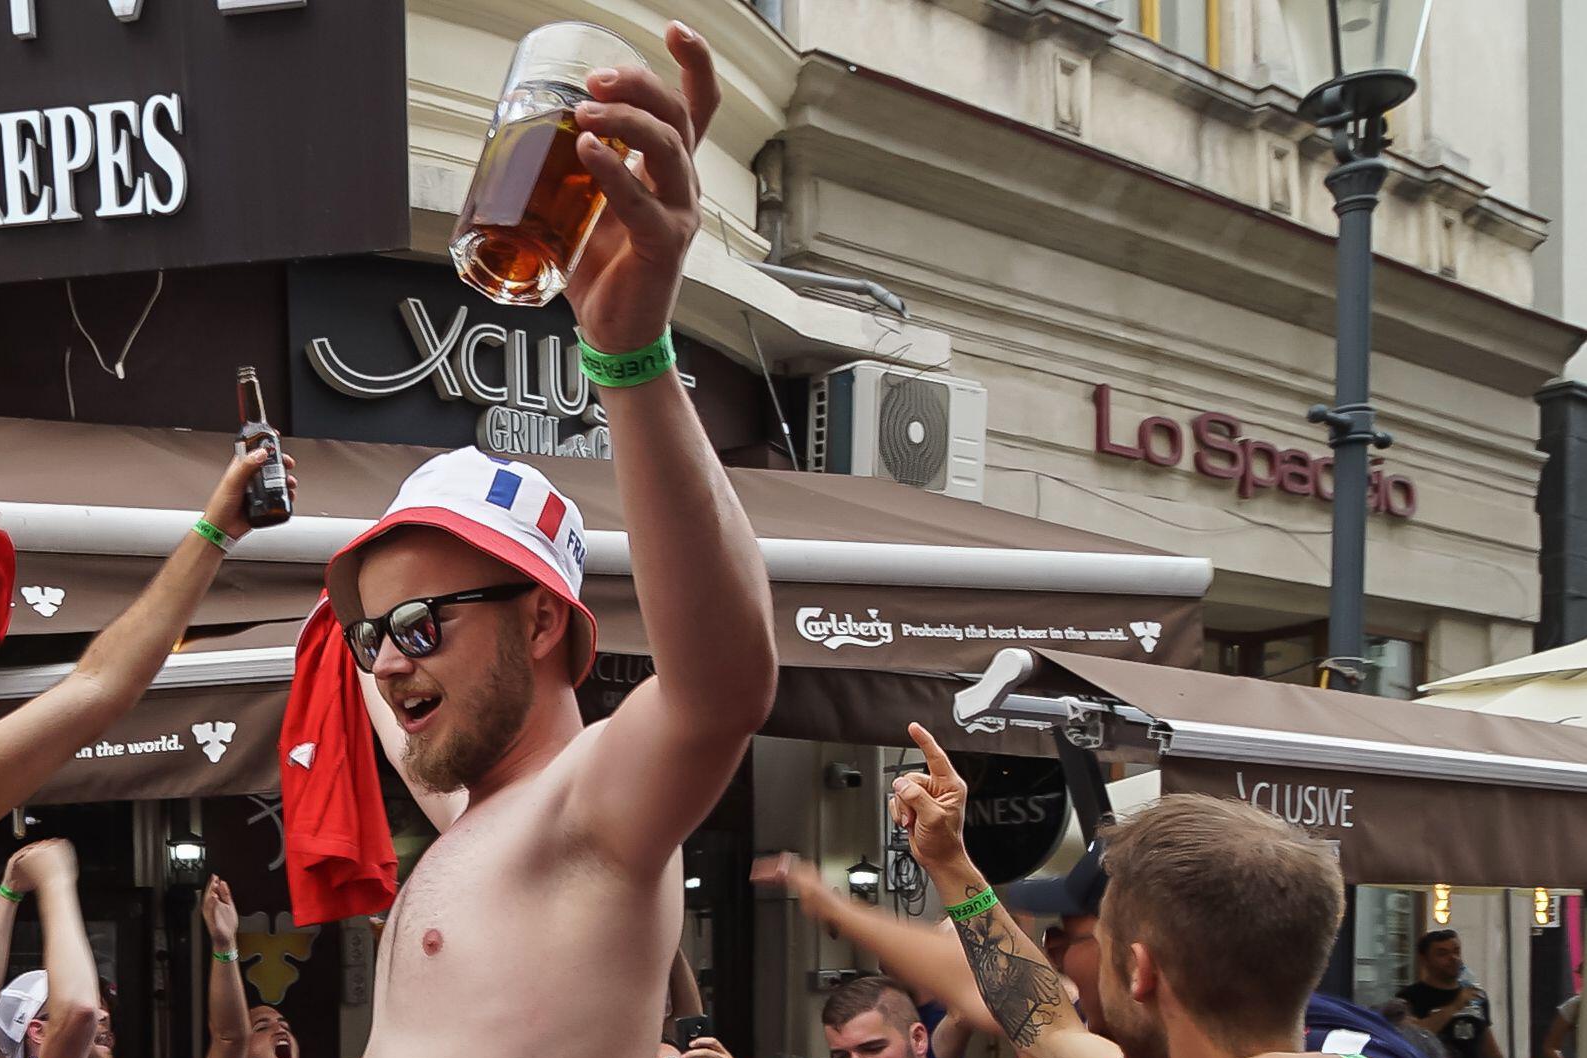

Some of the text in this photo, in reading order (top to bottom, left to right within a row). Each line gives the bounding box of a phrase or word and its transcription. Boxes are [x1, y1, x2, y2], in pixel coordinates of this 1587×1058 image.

[1094, 383, 1182, 466] Lo
[795, 606, 894, 650] Carlsberg
[95, 741, 125, 757] the
[127, 734, 184, 754] world.
